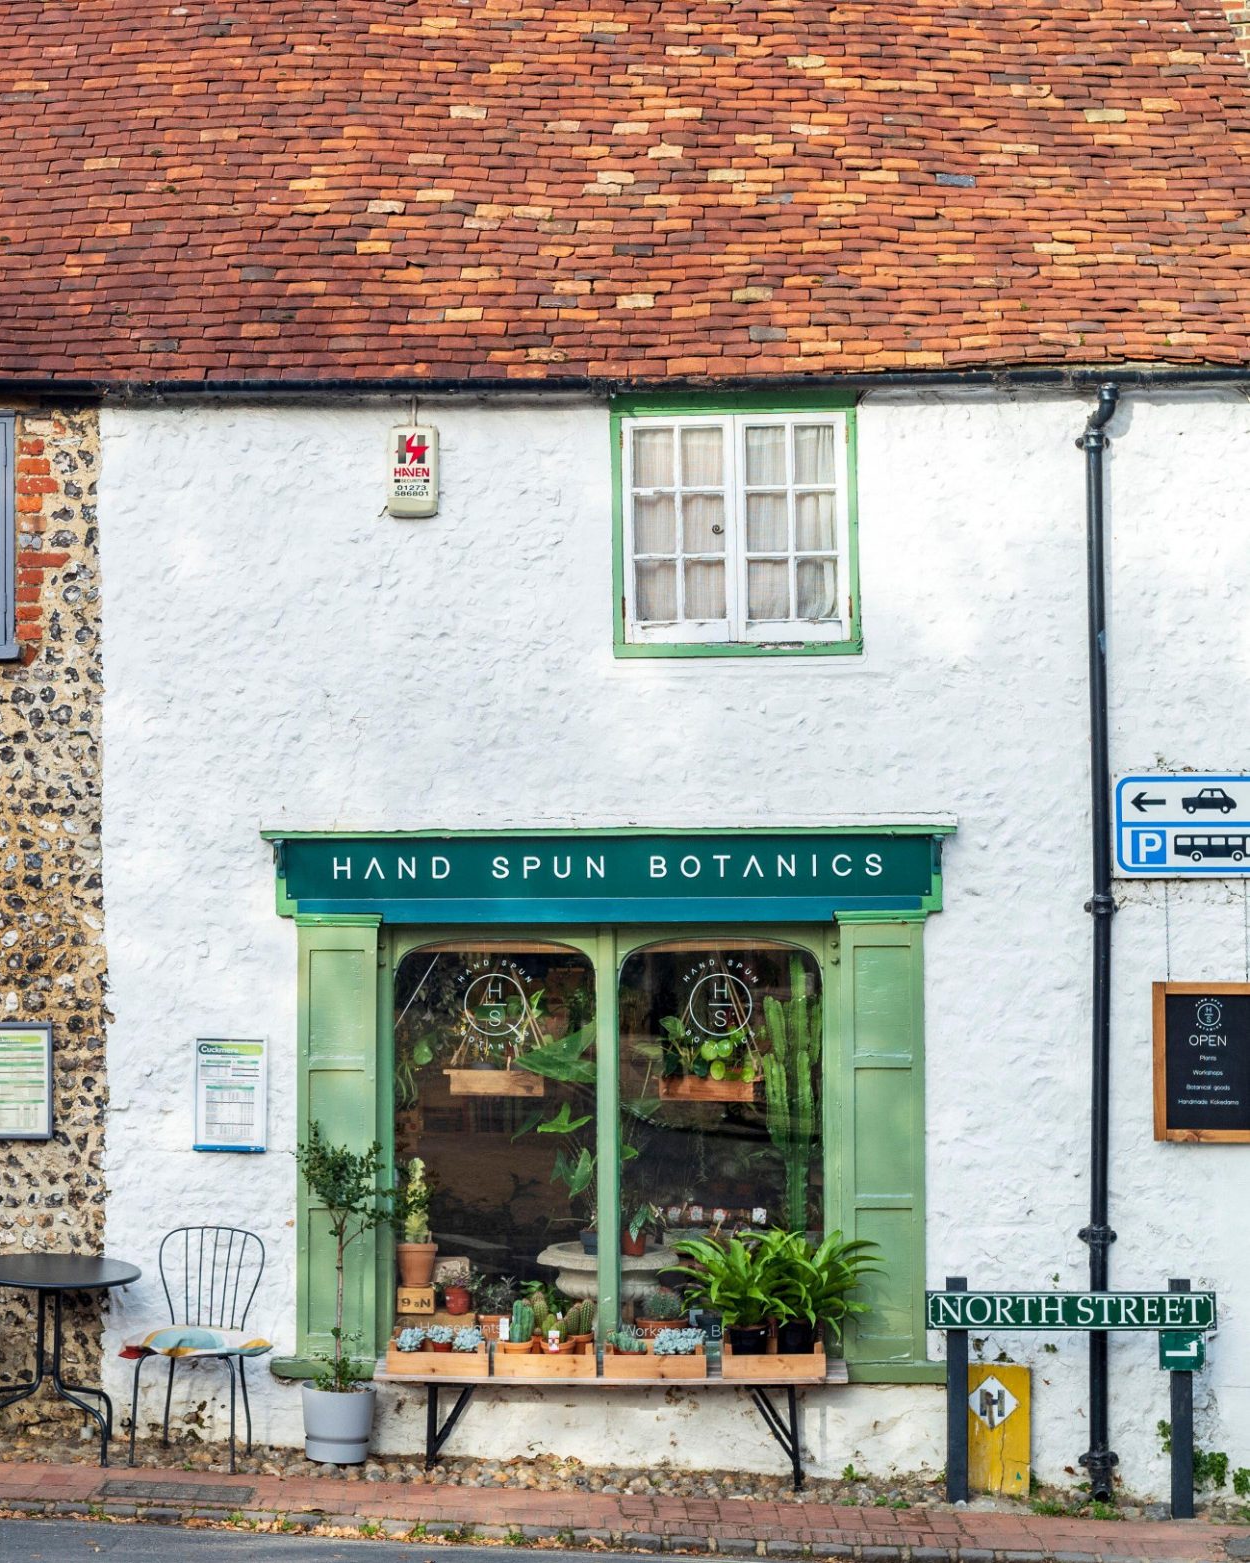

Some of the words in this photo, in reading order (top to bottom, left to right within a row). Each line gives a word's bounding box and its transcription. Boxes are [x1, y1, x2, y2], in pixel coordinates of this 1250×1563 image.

[394, 467, 430, 477] HAVEN
[1139, 832, 1162, 863] P
[333, 856, 451, 880] HAND
[492, 855, 605, 879] SPUN
[650, 853, 883, 878] BOTANICS
[457, 959, 490, 983] HAND
[501, 960, 533, 983] SPUN
[682, 959, 715, 982] HAND
[727, 959, 759, 983] SPUN
[488, 982, 502, 999] H
[714, 982, 728, 999] H
[488, 1010, 501, 1026] S
[714, 1010, 727, 1027] S
[1189, 1035, 1227, 1046] OPEN
[937, 1296, 1067, 1325] NORTH
[1077, 1296, 1205, 1325] STREET
